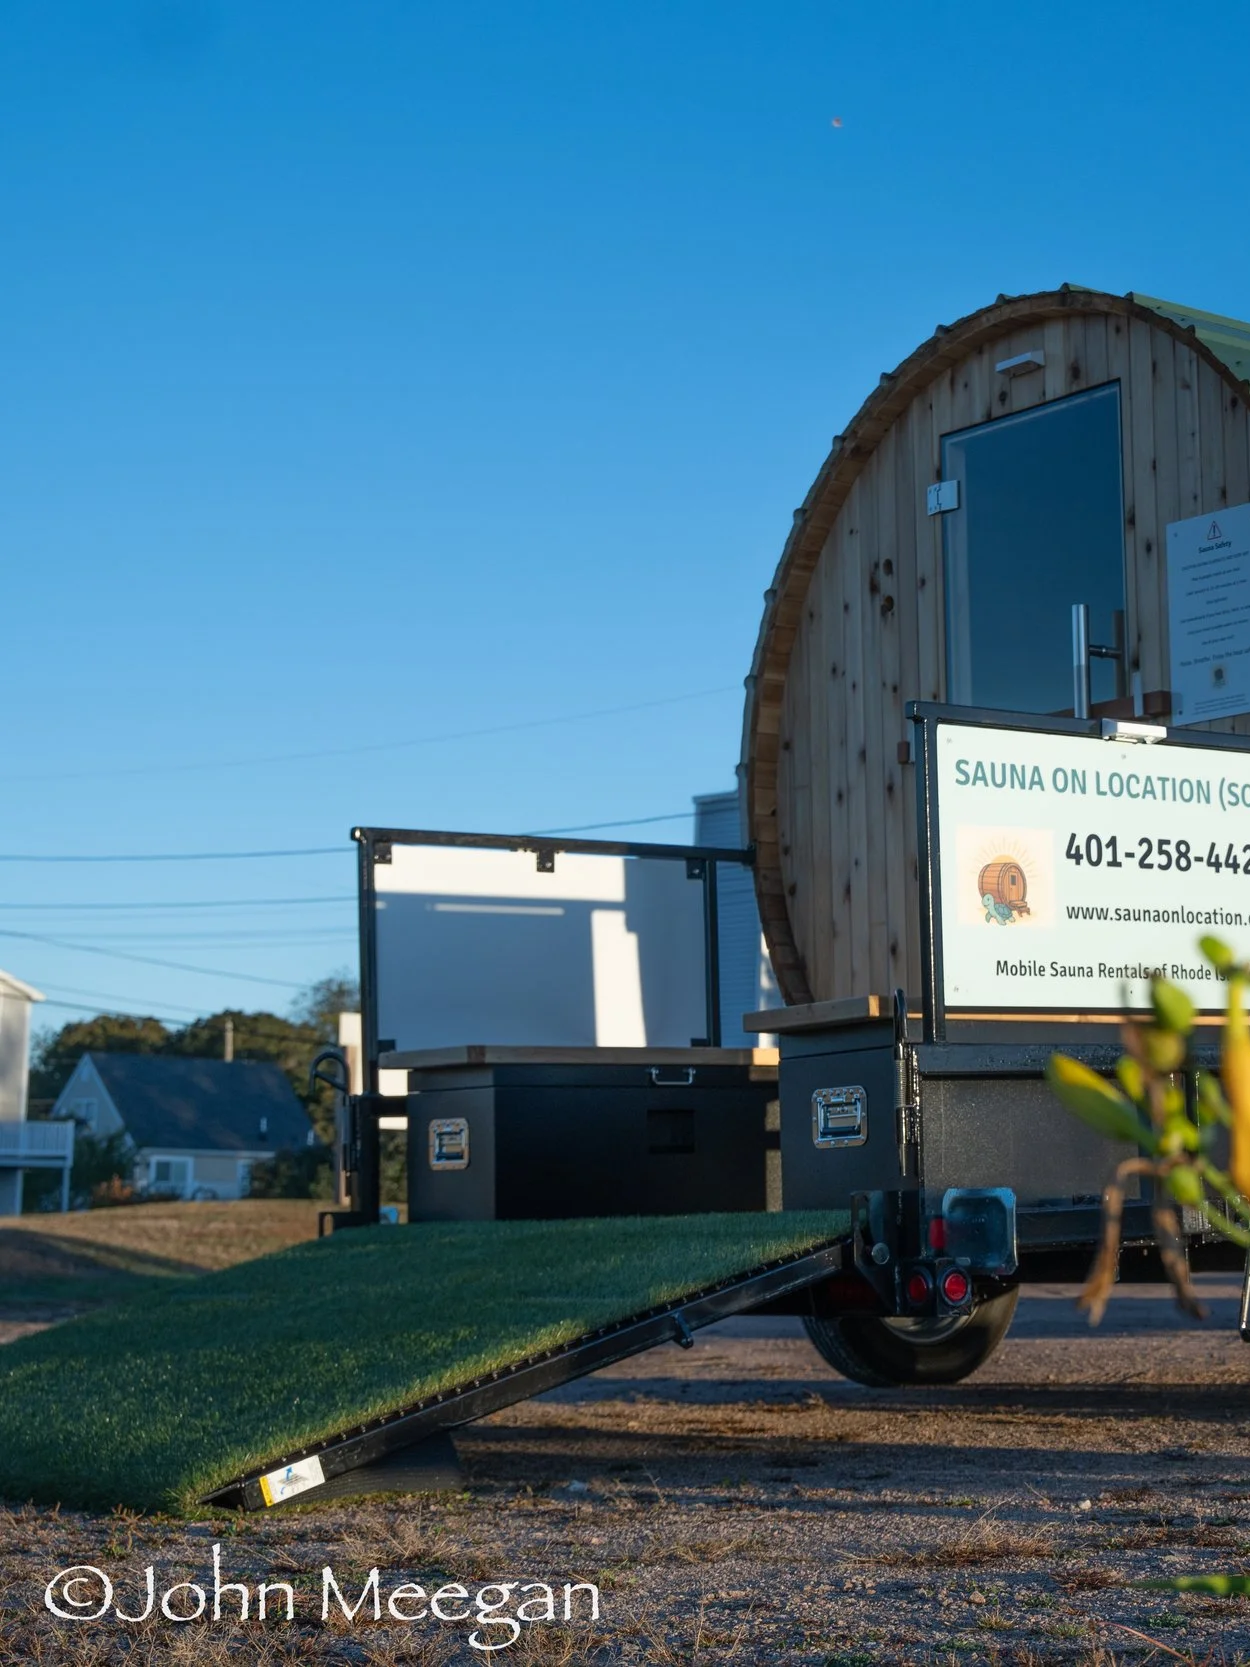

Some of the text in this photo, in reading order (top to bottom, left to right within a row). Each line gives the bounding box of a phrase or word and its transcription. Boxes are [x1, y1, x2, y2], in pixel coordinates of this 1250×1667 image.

[954, 759, 1045, 791] SAUNA
[1052, 768, 1087, 795] ON
[1095, 771, 1211, 805] LOCATION
[996, 960, 1046, 977] Mobile
[1050, 962, 1094, 978] Sauna
[1098, 962, 1149, 979] Rentals
[1154, 963, 1168, 979] of
[1171, 964, 1212, 981] Rhode
